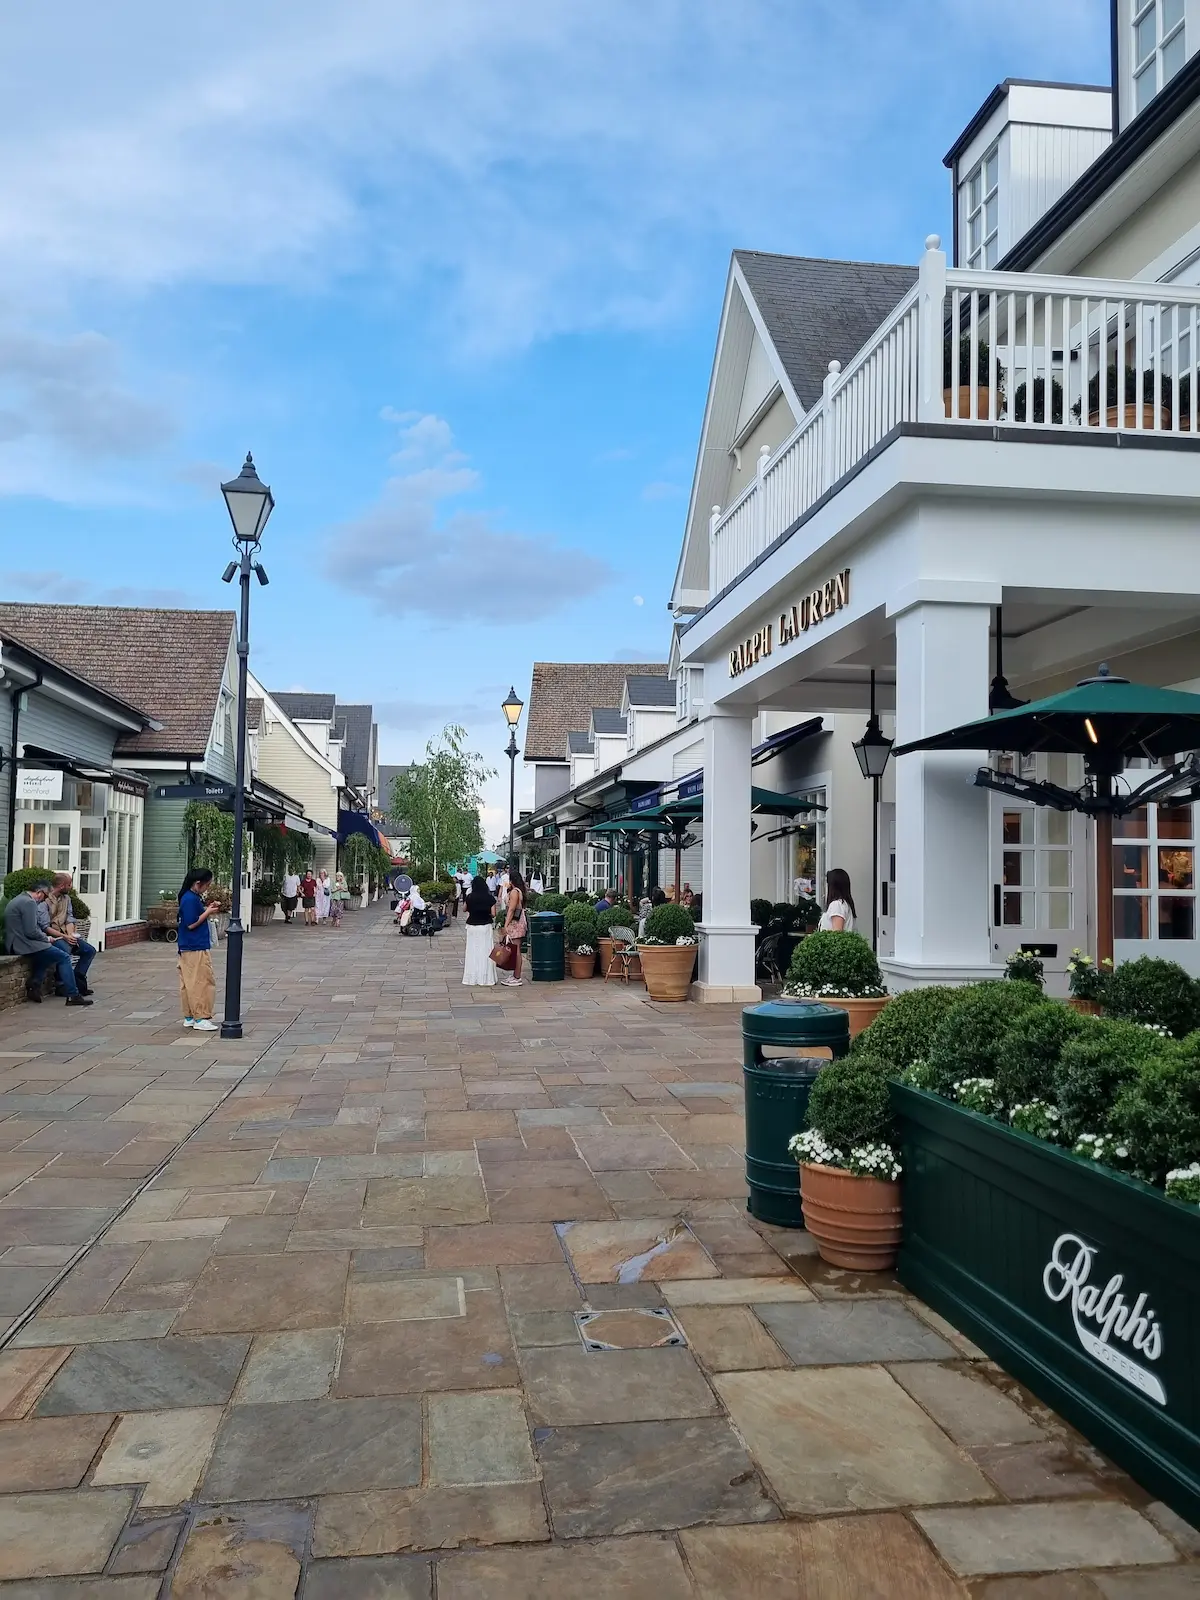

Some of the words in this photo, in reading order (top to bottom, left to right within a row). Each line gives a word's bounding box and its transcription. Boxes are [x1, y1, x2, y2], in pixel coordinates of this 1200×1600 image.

[728, 624, 772, 678] RALPH
[778, 568, 851, 646] LAUREN
[205, 787, 224, 795] Toilets
[1043, 1233, 1162, 1361] Ralph's
[1092, 1341, 1147, 1388] COFFEE
